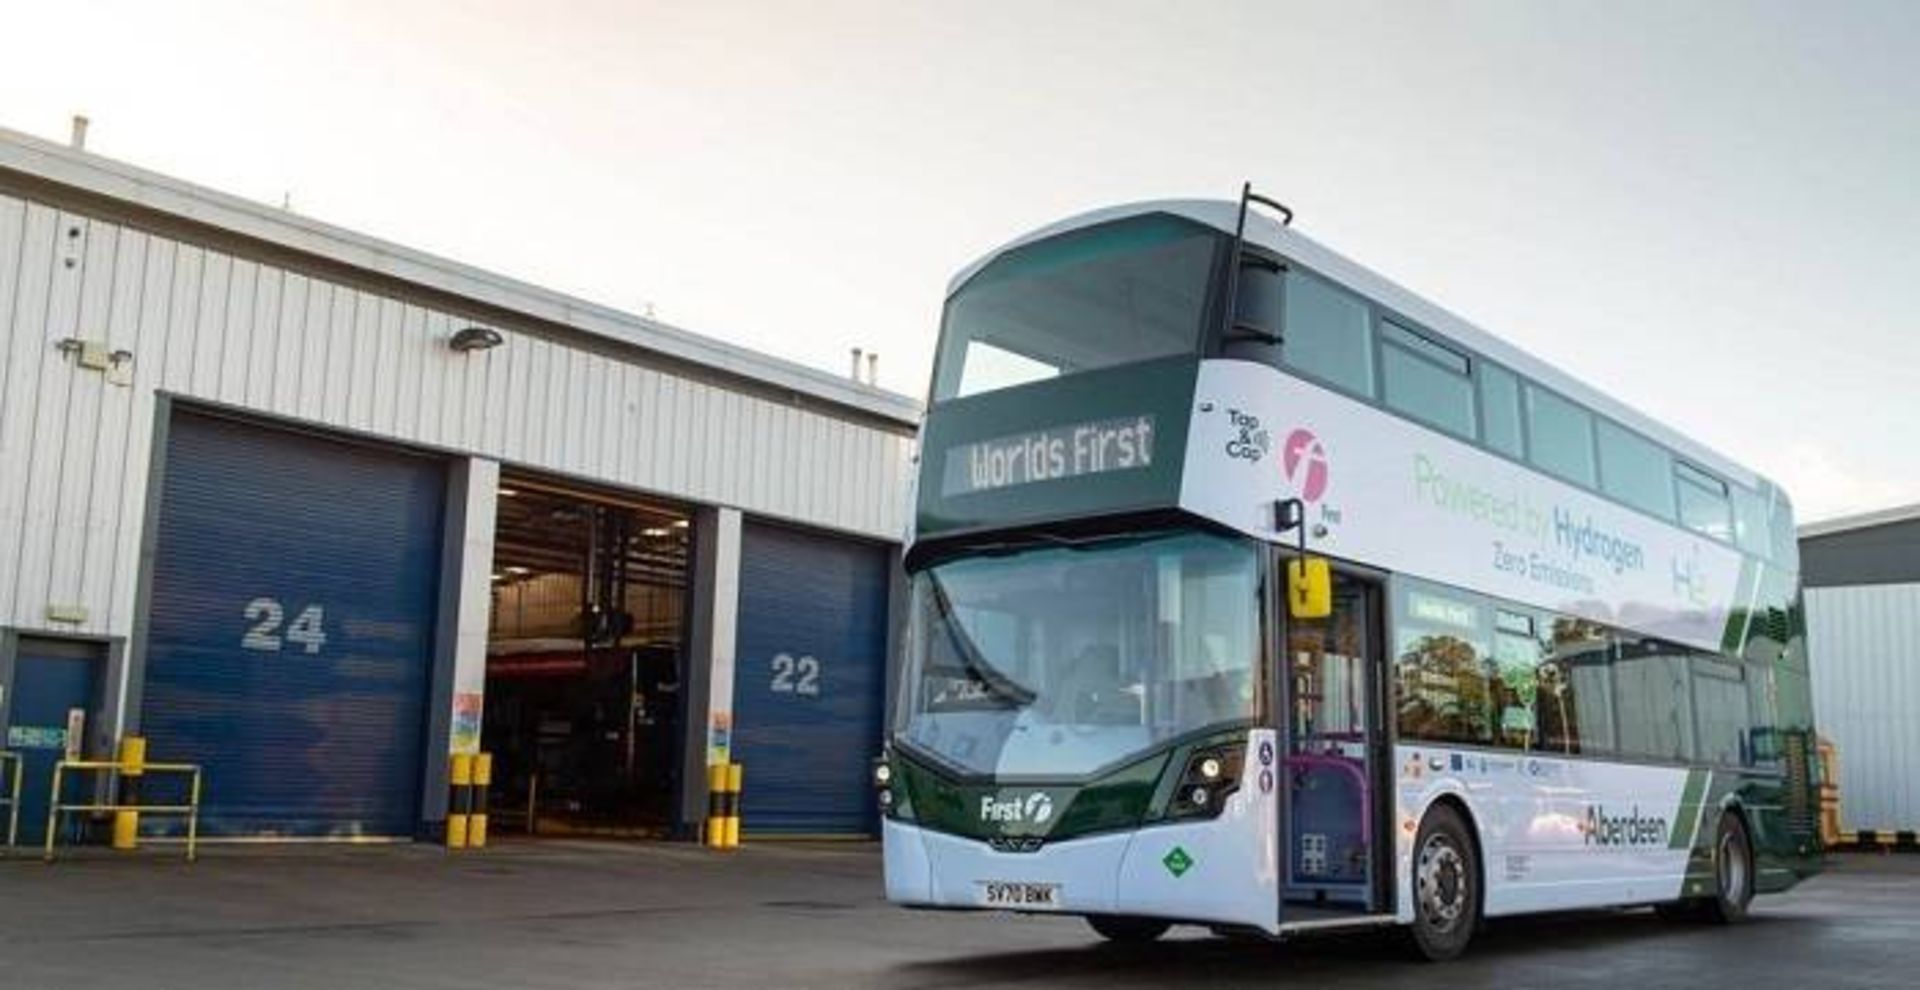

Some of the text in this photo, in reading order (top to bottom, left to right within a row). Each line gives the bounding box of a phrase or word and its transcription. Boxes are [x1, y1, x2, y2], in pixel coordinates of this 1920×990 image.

[1228, 409, 1260, 430] Tap
[971, 416, 1150, 489] Worlds First
[1226, 441, 1262, 463] Cap
[1415, 452, 1644, 574] Powered by Hydrogen
[1492, 540, 1527, 575] Zero
[241, 597, 327, 653] 24
[771, 654, 819, 693] 22
[982, 796, 1022, 820] First
[1584, 804, 1666, 845] Aberdeen
